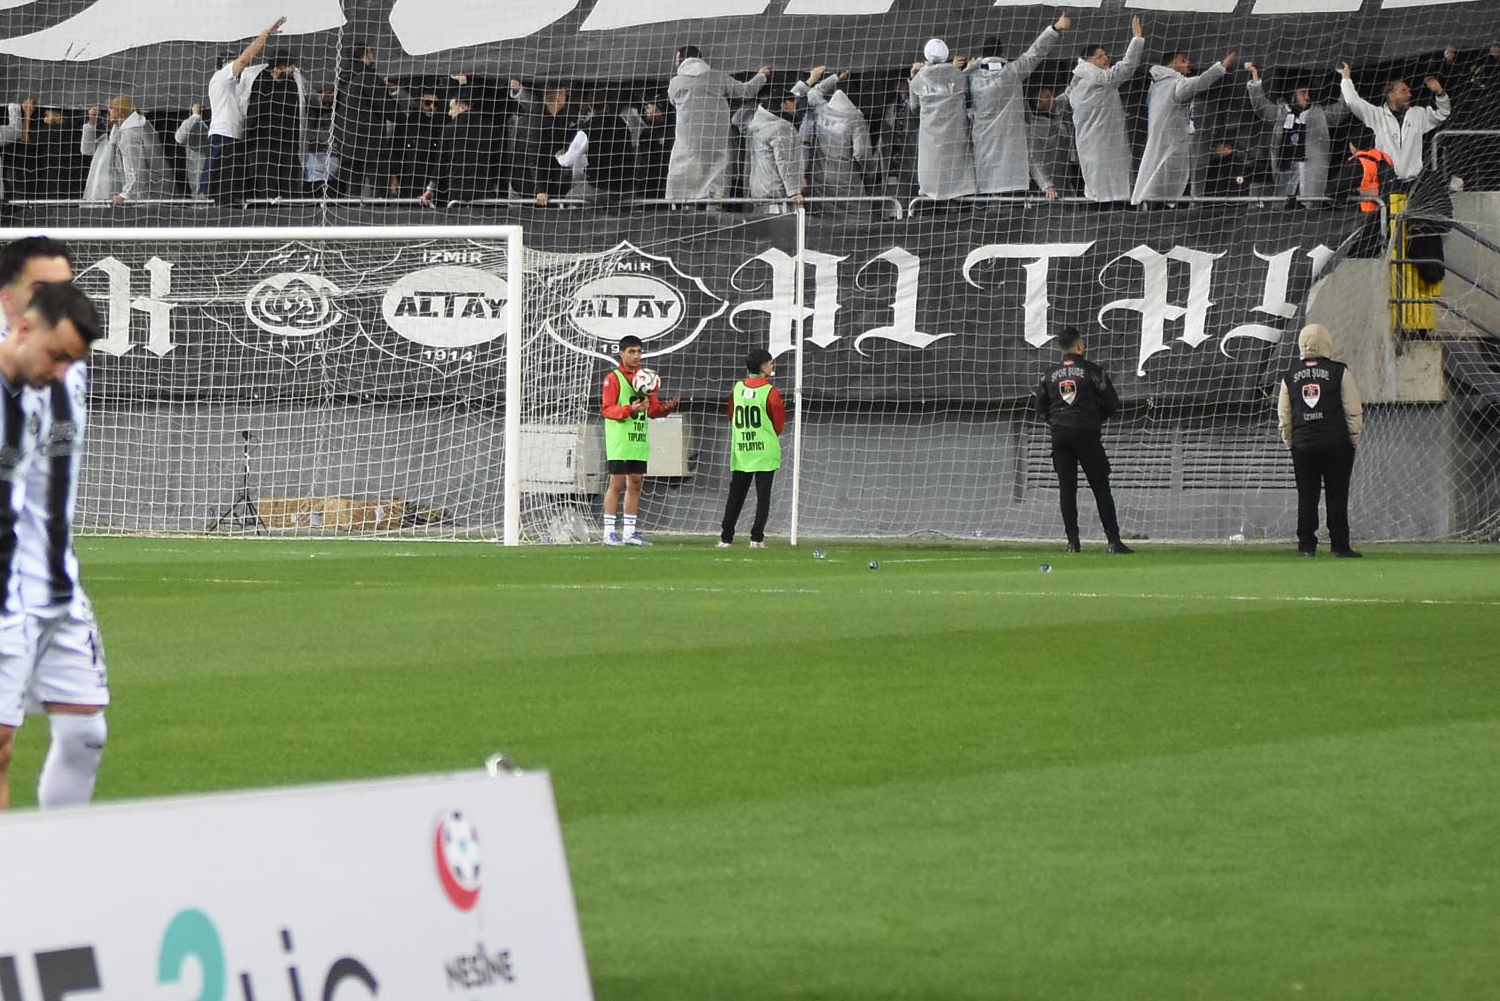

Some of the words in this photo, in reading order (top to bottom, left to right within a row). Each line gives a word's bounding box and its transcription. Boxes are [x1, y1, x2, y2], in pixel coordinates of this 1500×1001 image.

[422, 249, 483, 264] İZMİR
[395, 291, 508, 319] ALTAY
[575, 295, 676, 319] ALTAY
[425, 350, 473, 362] 1914
[633, 421, 645, 432] TOP
[734, 405, 762, 430] 010
[741, 431, 757, 442] TOP
[446, 941, 517, 993] NESİNE
